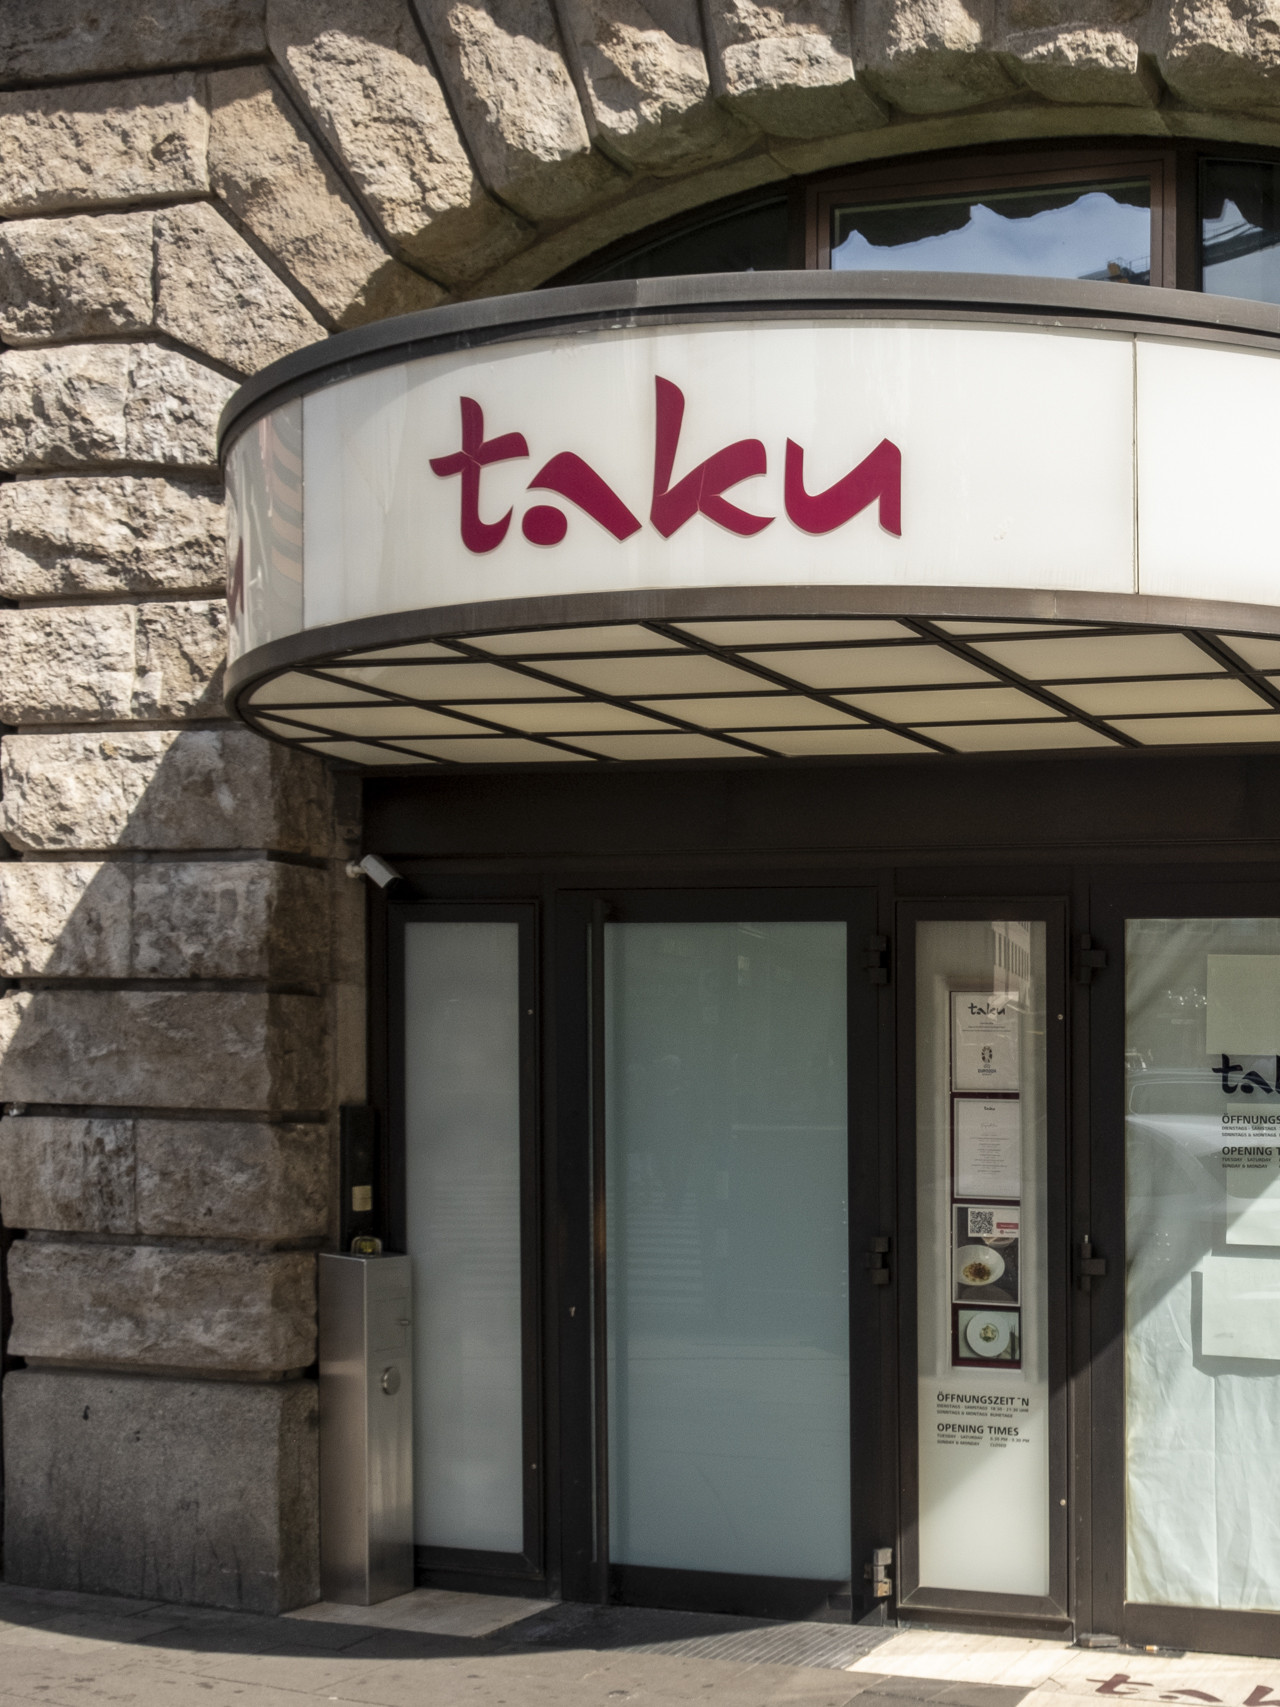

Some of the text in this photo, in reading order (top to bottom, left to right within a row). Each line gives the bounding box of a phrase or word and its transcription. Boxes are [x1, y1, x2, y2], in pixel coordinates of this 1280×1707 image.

[429, 375, 902, 554] taku
[968, 1002, 1006, 1016] taku
[1221, 1146, 1273, 1156] OPENING
[936, 1390, 1029, 1407] ÖFFNUNGSZEITN
[937, 1422, 1019, 1437] OPENING TIMES
